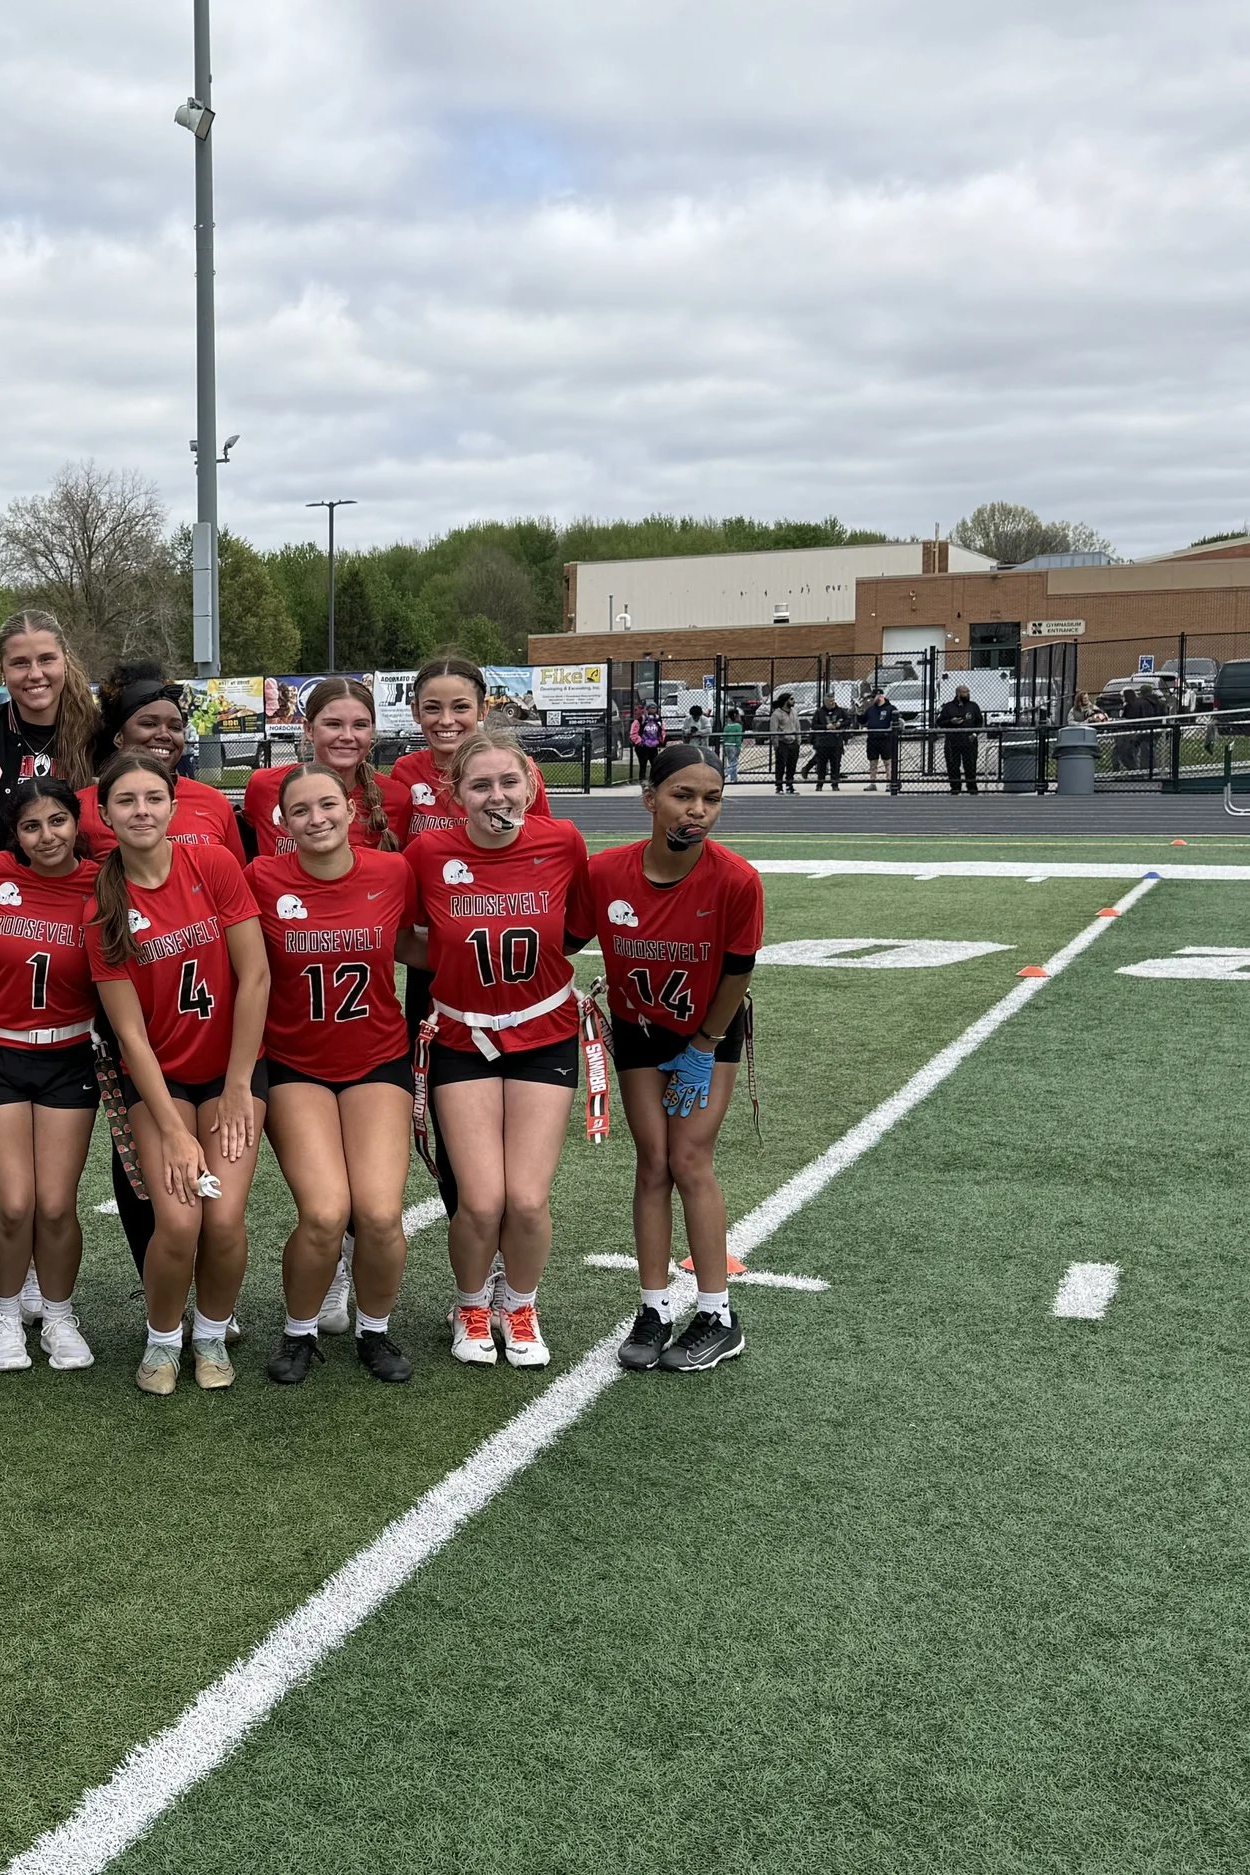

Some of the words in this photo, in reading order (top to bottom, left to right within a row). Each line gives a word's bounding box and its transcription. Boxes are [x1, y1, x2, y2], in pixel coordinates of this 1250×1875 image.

[540, 668, 583, 685] Fike
[450, 891, 550, 917] ROOSEVELT
[285, 926, 383, 953] ROOSEVELT
[464, 926, 540, 987] 10
[613, 935, 711, 962] ROOSEVELT
[25, 951, 51, 1010] 1
[178, 959, 215, 1020] 4
[300, 961, 371, 1023] 12
[627, 967, 695, 1022] 14
[586, 1043, 607, 1094] BROWNS
[412, 1072, 427, 1132] BROWNS
